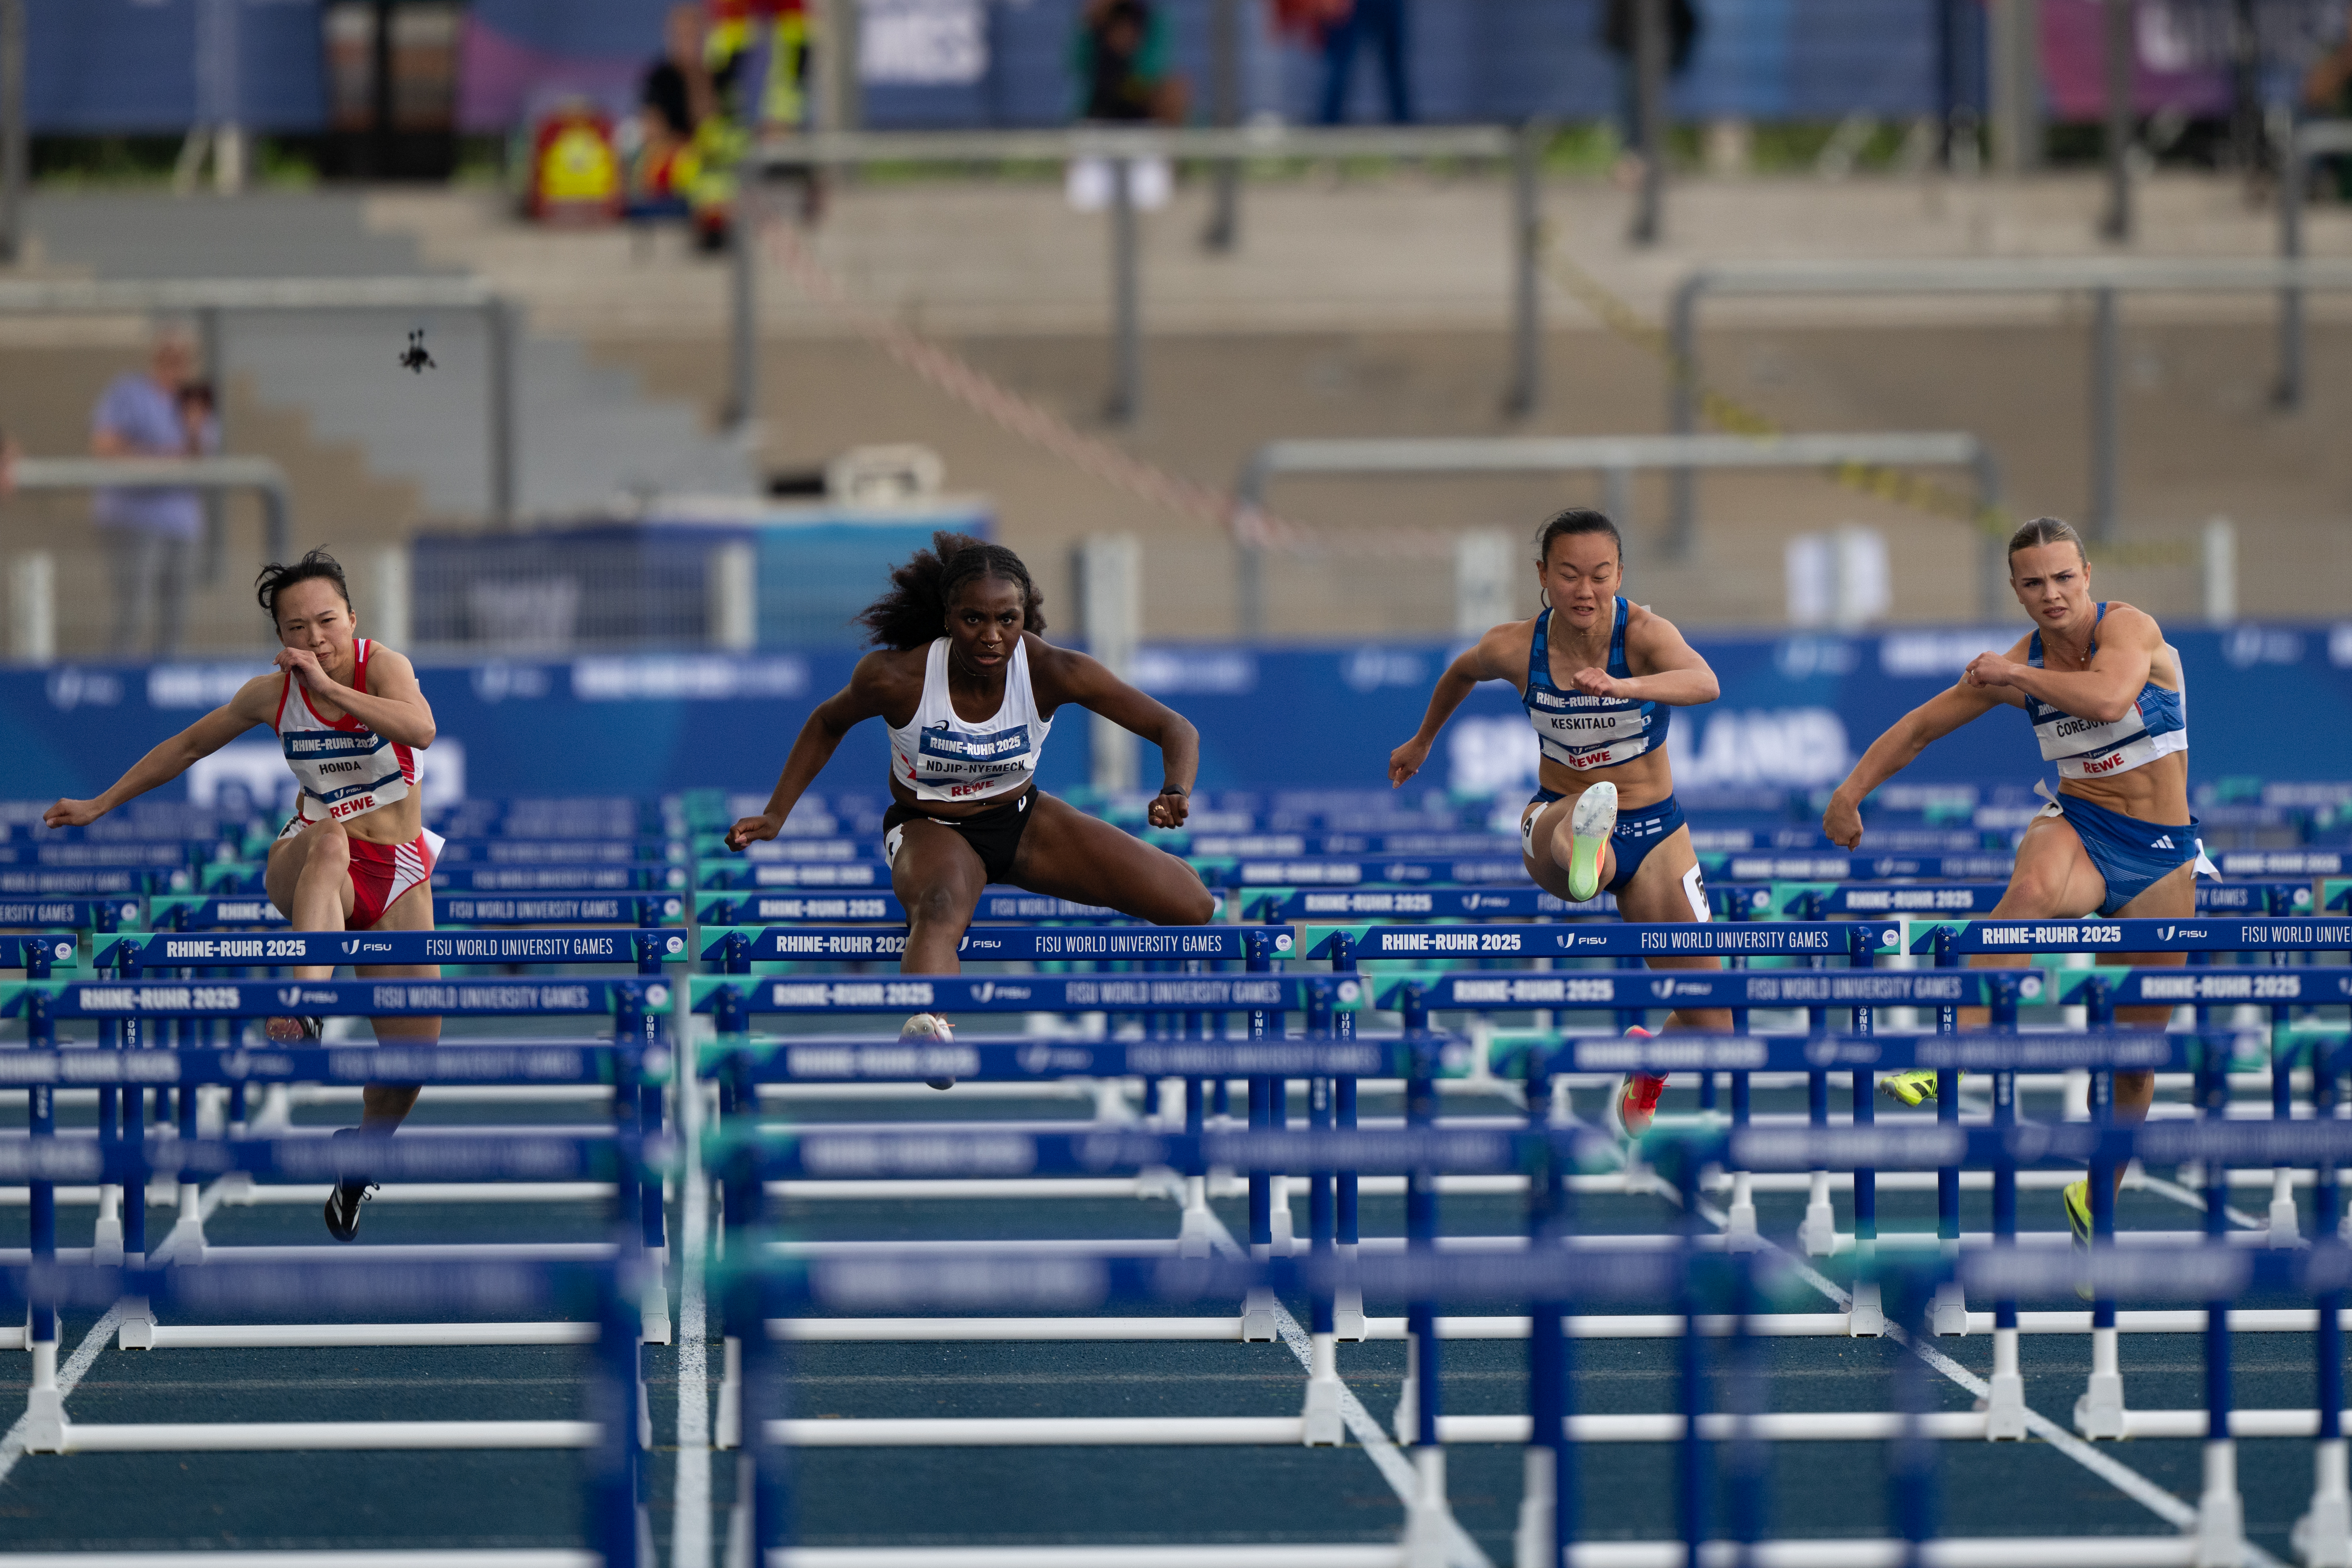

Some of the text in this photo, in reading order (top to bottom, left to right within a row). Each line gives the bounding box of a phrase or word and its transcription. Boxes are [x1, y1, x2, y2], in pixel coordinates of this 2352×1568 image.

[1537, 692, 1600, 708] RHINE-RUHR
[1551, 717, 1616, 730] KESKITALO
[2056, 720, 2109, 737] ČOREJO
[292, 734, 378, 752] RHINE-RUHR 2025
[930, 736, 1021, 755] RHINE-RUHR 2025
[926, 759, 1026, 773] NDJIP-NYEMECK
[1569, 751, 1612, 767] REWE
[2083, 753, 2124, 773] REWE
[319, 761, 362, 775] HONDA
[951, 780, 995, 797] REWE
[329, 795, 375, 819] REWE
[218, 903, 284, 920] RHINE-R
[1383, 934, 1521, 950] RHINE-RUHR 2025
[1642, 931, 1828, 948] FISU WORLD UNIVERSITY GAMES
[1983, 926, 2121, 944] RHINE-RUHR 2025
[2242, 927, 2352, 942] FISU WORLD UNIVE
[167, 940, 306, 957] RHINE-RUHR 2025
[427, 938, 612, 955] FISU WORLD UNIVERSITY GAMES
[777, 936, 872, 952] RHINE-RUHR
[1037, 935, 1221, 952] FISU WORLD UNIVERSITY GAMES
[1341, 1010, 1350, 1042] OND
[1858, 1006, 1868, 1037] OND
[127, 1017, 136, 1049] OND
